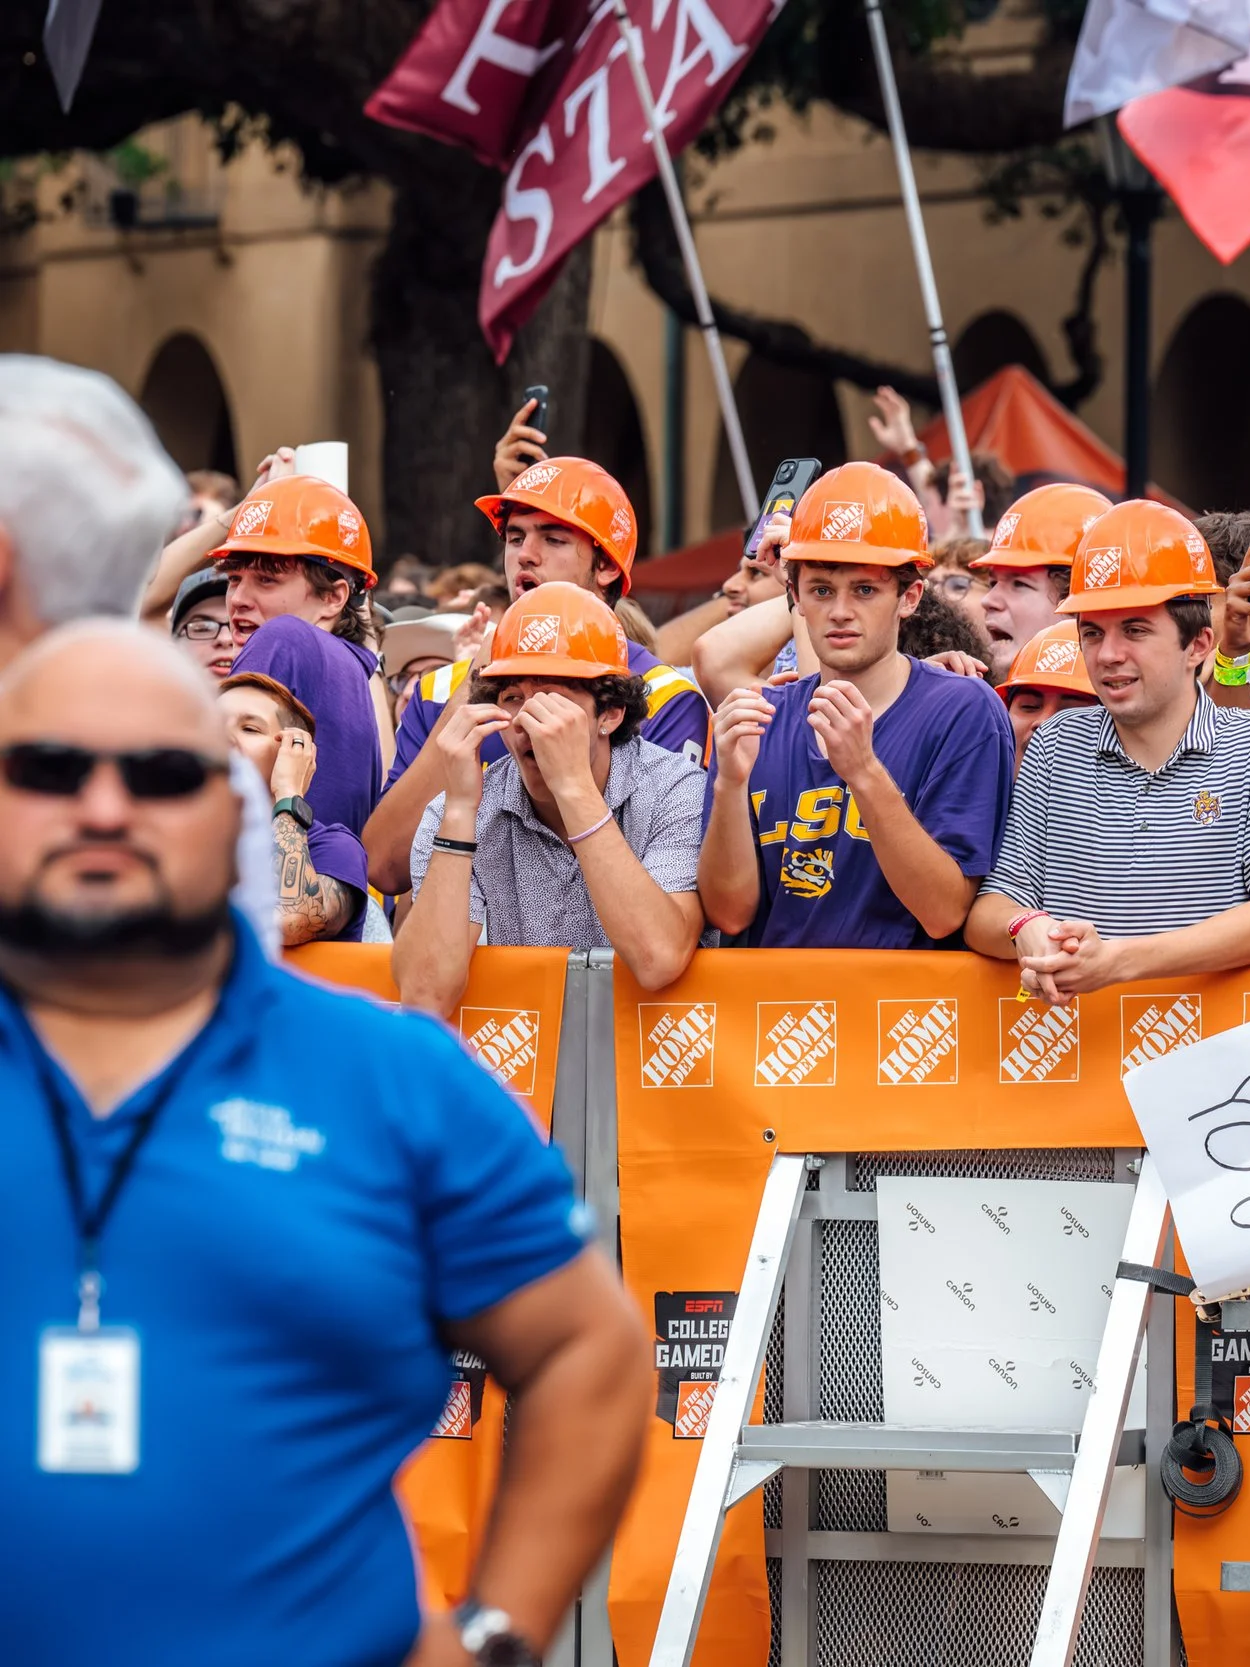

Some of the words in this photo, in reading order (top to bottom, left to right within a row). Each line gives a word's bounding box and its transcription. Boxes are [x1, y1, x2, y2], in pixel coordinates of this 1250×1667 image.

[822, 503, 863, 540] HOME
[836, 516, 861, 540] DEPOT
[1085, 547, 1120, 588] HOME
[1097, 561, 1119, 587] DEPOT
[518, 615, 559, 652] HOME
[532, 628, 557, 652] DEPOT
[1037, 641, 1079, 671] HOME
[467, 1018, 501, 1049] THE
[648, 1012, 677, 1045] THE
[766, 1011, 798, 1045] THE
[887, 1009, 919, 1043] THE
[1008, 1007, 1041, 1040] THE
[1122, 994, 1200, 1069] HOME
[1130, 1004, 1163, 1038] THE
[476, 1011, 539, 1072] OME
[642, 1003, 714, 1087] HOME
[756, 1001, 835, 1084] HOME
[787, 1033, 835, 1084] DEPOT
[879, 1000, 957, 1083] HOME
[909, 1030, 957, 1082] DEPOT
[1001, 1004, 1078, 1081] HOME
[1030, 1028, 1078, 1081] DEPOT
[495, 1042, 536, 1083] EPOT
[670, 1033, 714, 1087] DEPOT
[685, 1300, 724, 1313] ESPN
[656, 1344, 724, 1368] GAMED
[691, 1372, 706, 1380] BUILT
[706, 1372, 713, 1380] BY
[1069, 1361, 1094, 1387] ANSON
[683, 1387, 702, 1409] THE
